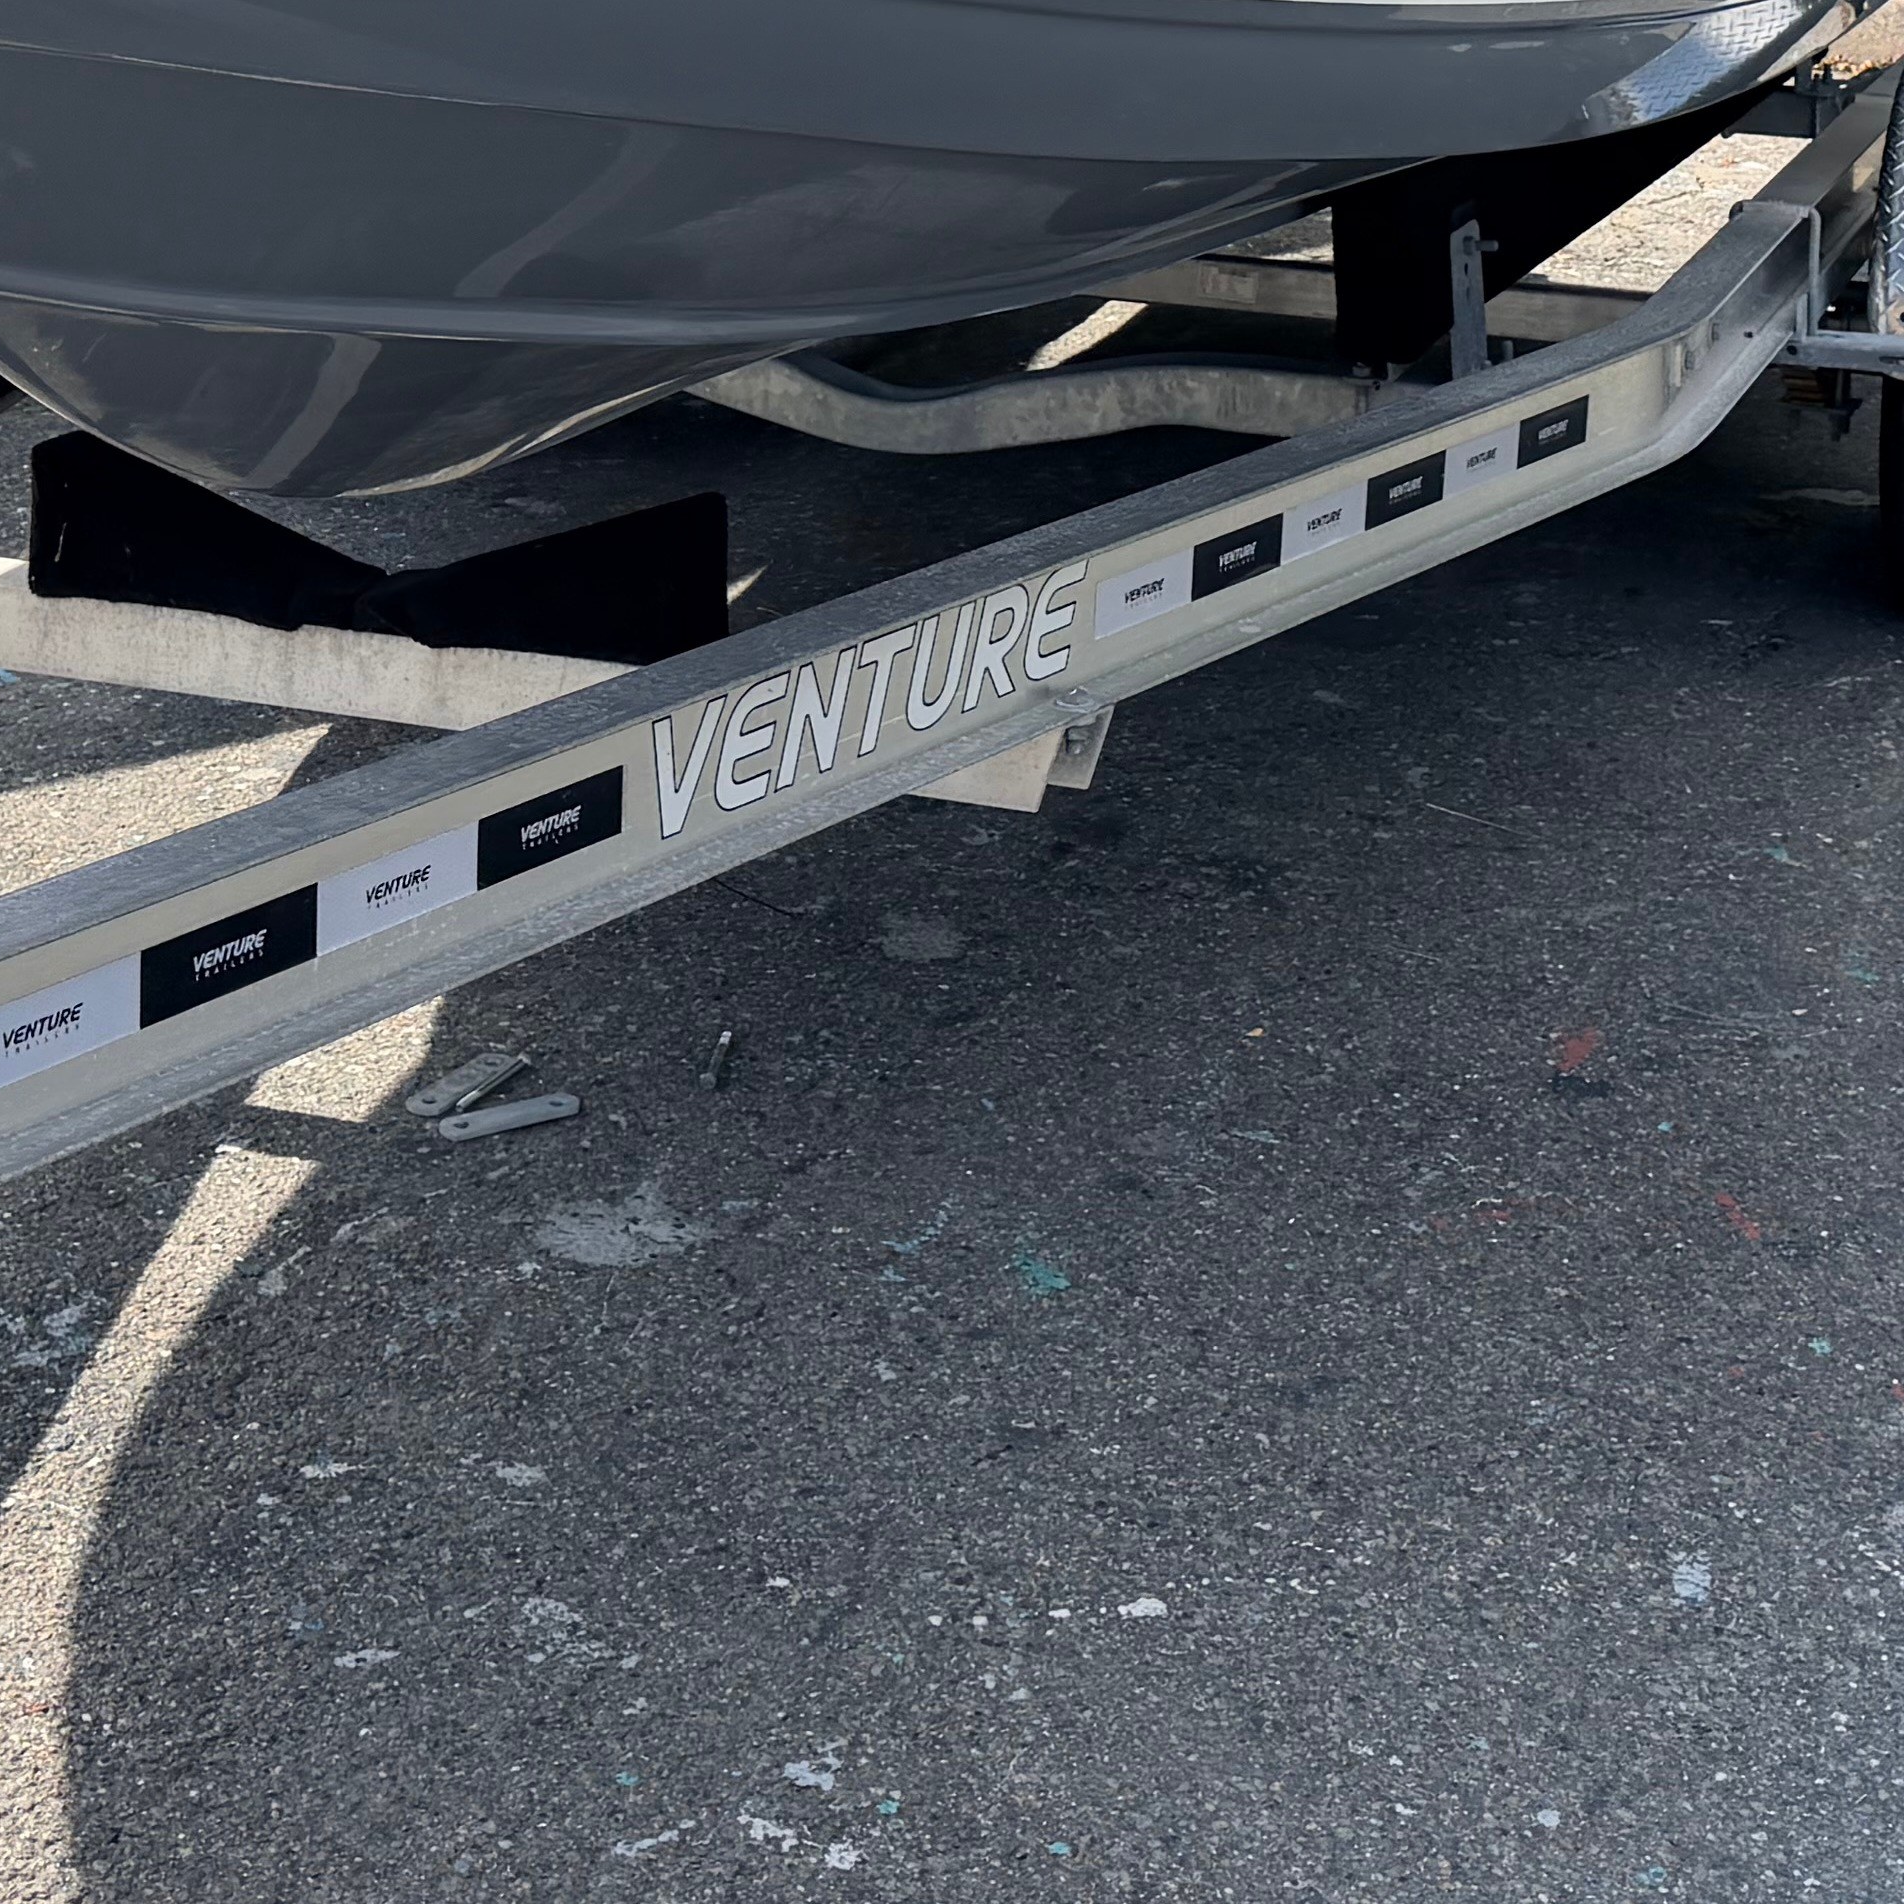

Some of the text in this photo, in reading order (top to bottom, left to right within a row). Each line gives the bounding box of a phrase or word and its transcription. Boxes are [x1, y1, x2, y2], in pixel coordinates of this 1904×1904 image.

[652, 559, 1090, 840] VENTURE
[521, 804, 582, 843] VENTURE
[366, 864, 431, 904] VENTURE
[193, 928, 267, 973] VENTURE
[3, 1002, 83, 1049] VENTURE
